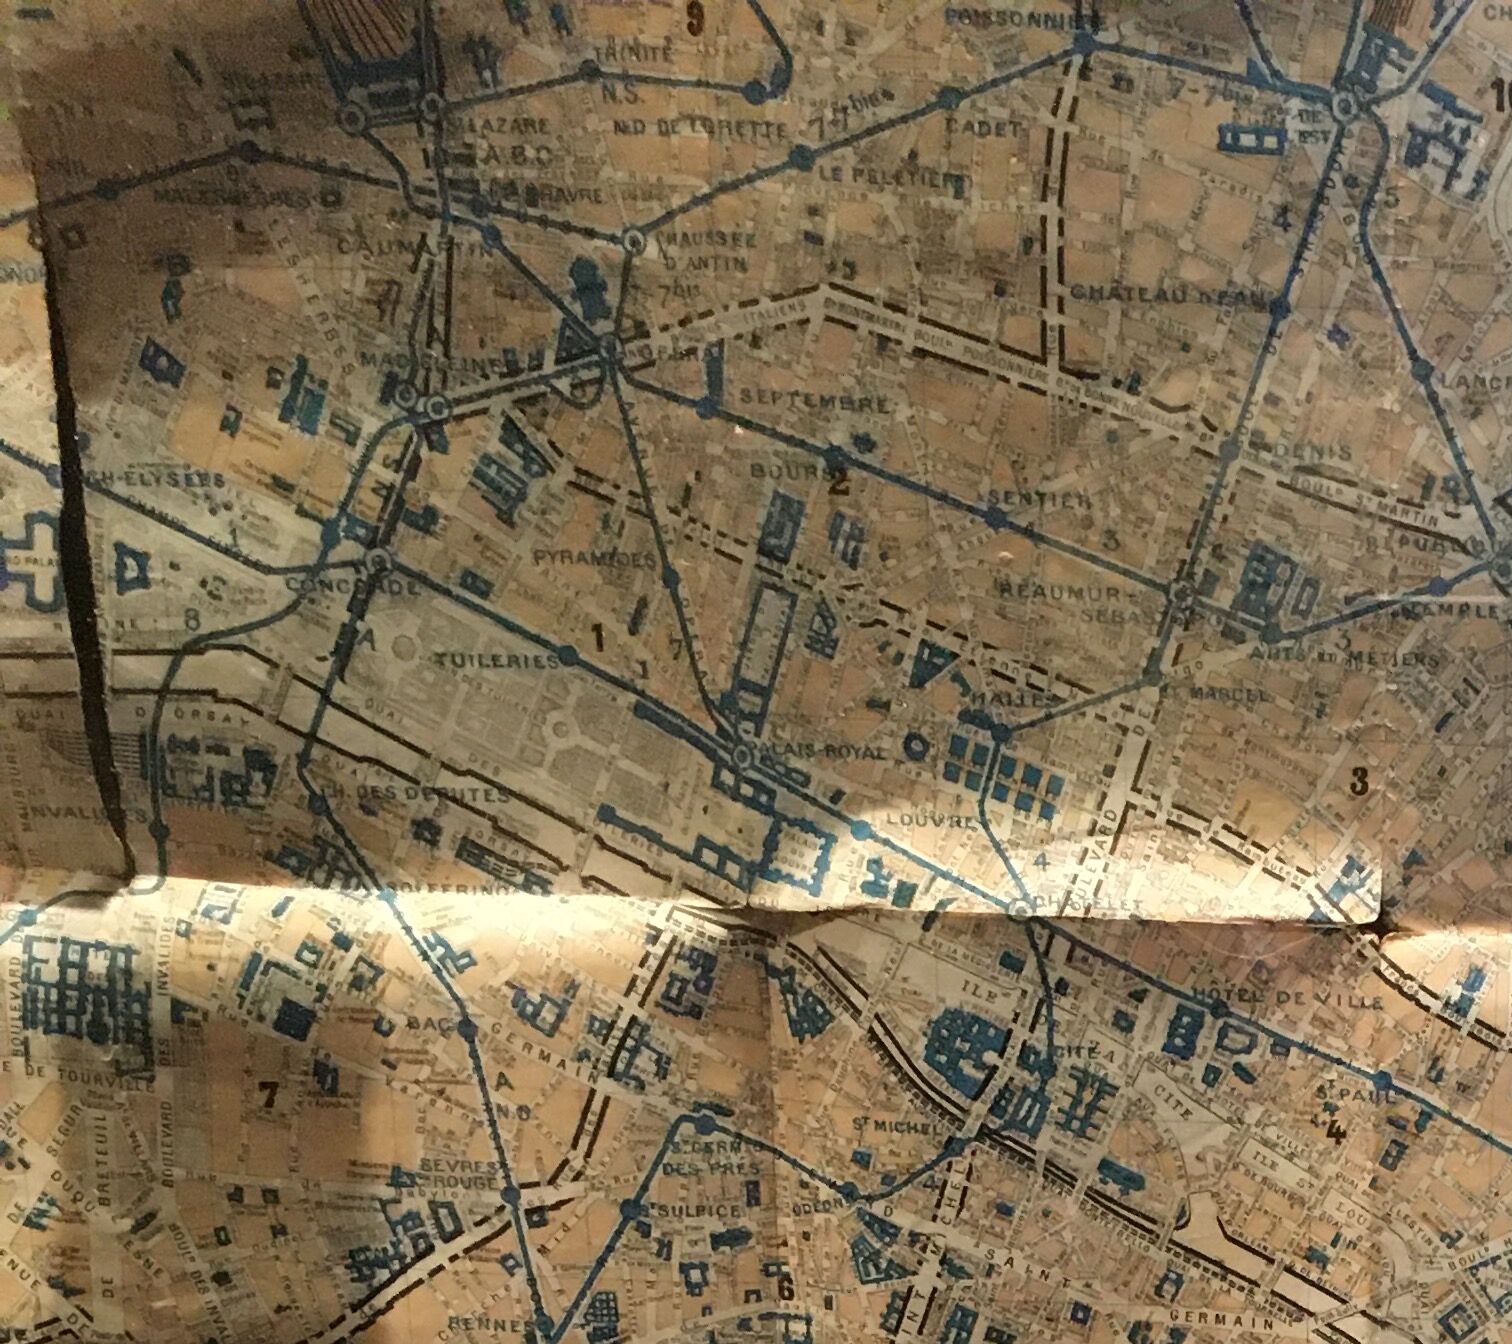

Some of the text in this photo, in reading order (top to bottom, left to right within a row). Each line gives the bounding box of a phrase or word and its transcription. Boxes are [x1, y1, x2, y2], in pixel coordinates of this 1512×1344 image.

[686, 0, 705, 37] 9
[689, 117, 788, 141] LORETTE
[945, 116, 1022, 140] CADET
[819, 164, 843, 183] LE
[740, 387, 890, 414] SEPTEMBRE
[1271, 442, 1354, 463] DENIS
[828, 465, 851, 498] 2
[988, 489, 1093, 511] SENTIER
[532, 547, 657, 568] PYRAMIDES
[285, 576, 421, 597] CONCORDE
[184, 608, 202, 633] 8
[1403, 601, 1501, 621] TEMPLE
[356, 630, 378, 652] A
[432, 651, 562, 672] TUILERIES
[1195, 686, 1270, 704] MARCEL
[1350, 765, 1371, 797] 3
[357, 783, 399, 802] DES
[156, 913, 176, 998] INVALIDES
[1276, 991, 1306, 1006] DE
[1317, 992, 1385, 1012] VILLE
[407, 1014, 452, 1033] BAC
[490, 1019, 600, 1085] GERMAIN
[56, 1066, 156, 1094] TOURVILLE
[258, 1079, 280, 1109] 7
[1338, 1086, 1399, 1106] PAUL
[873, 1118, 943, 1139] MICHEL
[160, 1099, 176, 1190] BOULEVARD
[657, 1202, 741, 1220] SULPICE
[776, 1277, 796, 1302] 6
[1168, 1307, 1276, 1333] GERMAIN
